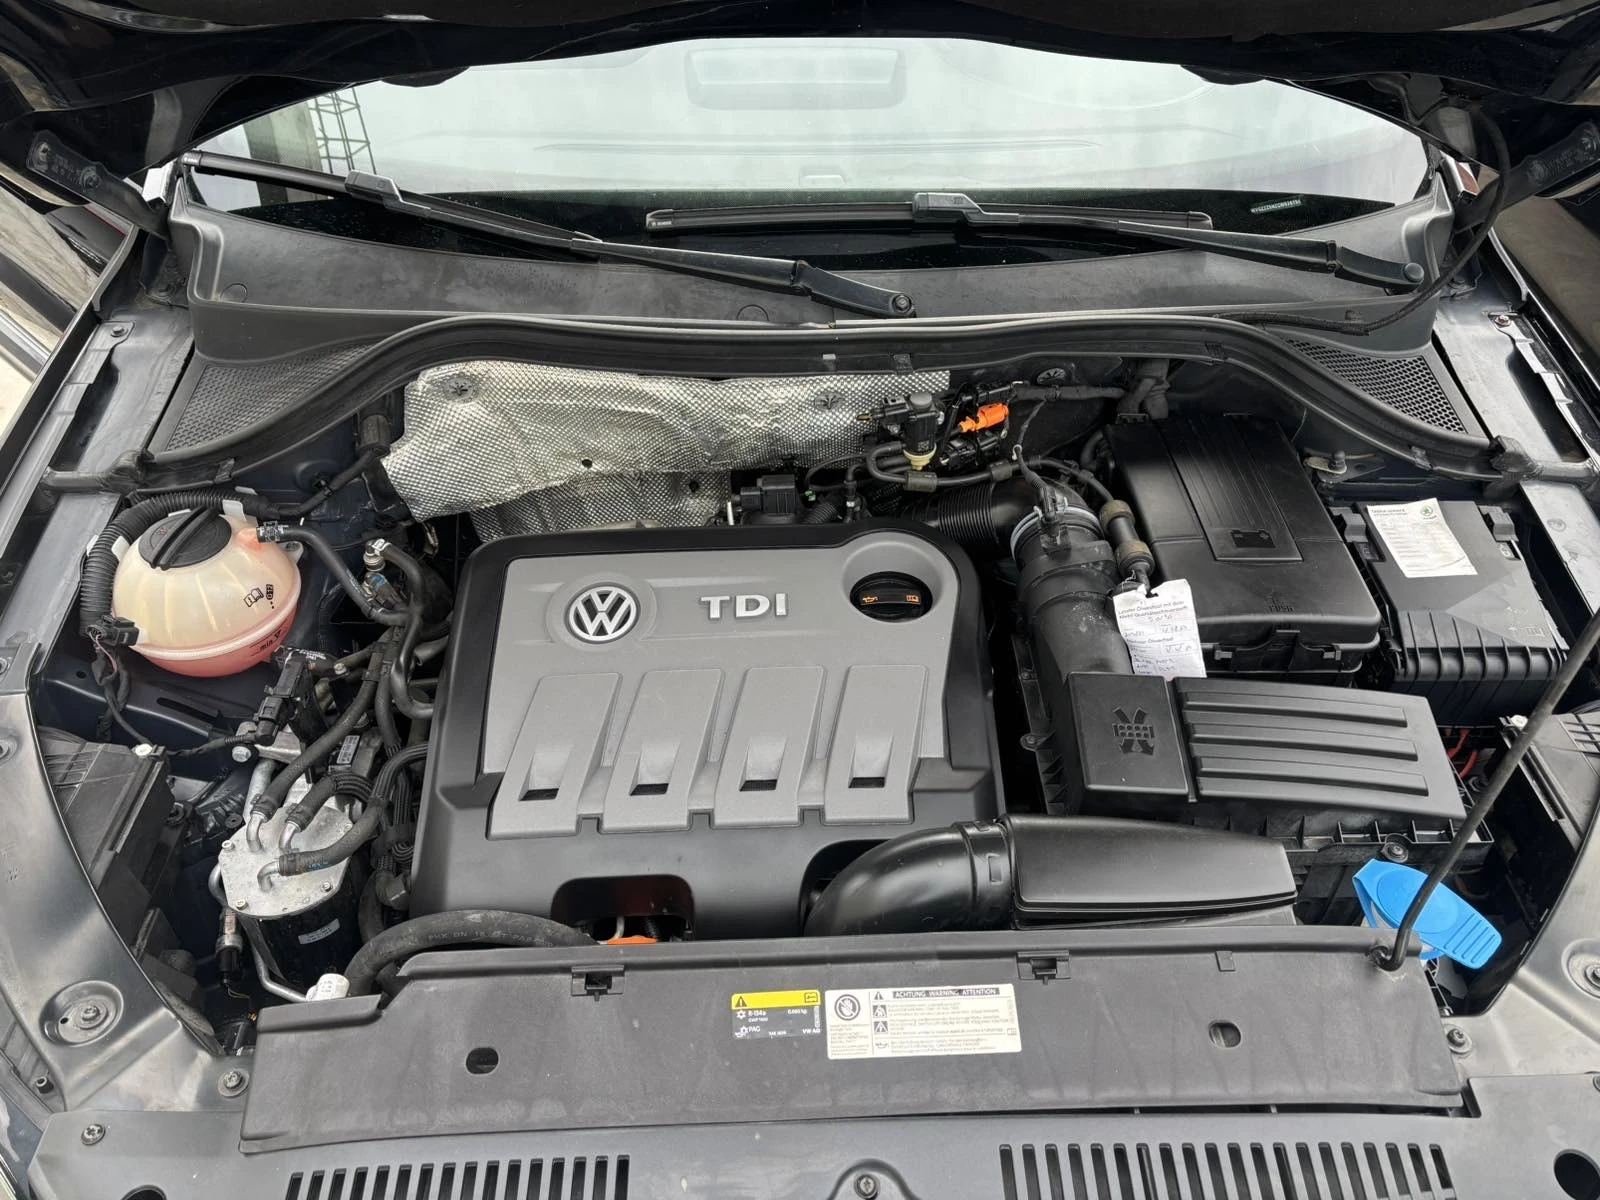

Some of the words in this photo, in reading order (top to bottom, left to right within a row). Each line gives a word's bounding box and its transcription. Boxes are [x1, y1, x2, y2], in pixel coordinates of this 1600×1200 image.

[569, 585, 637, 641] VW
[700, 593, 787, 619] TDI
[929, 989, 959, 997] WARNING
[962, 987, 996, 996] ATTENTION
